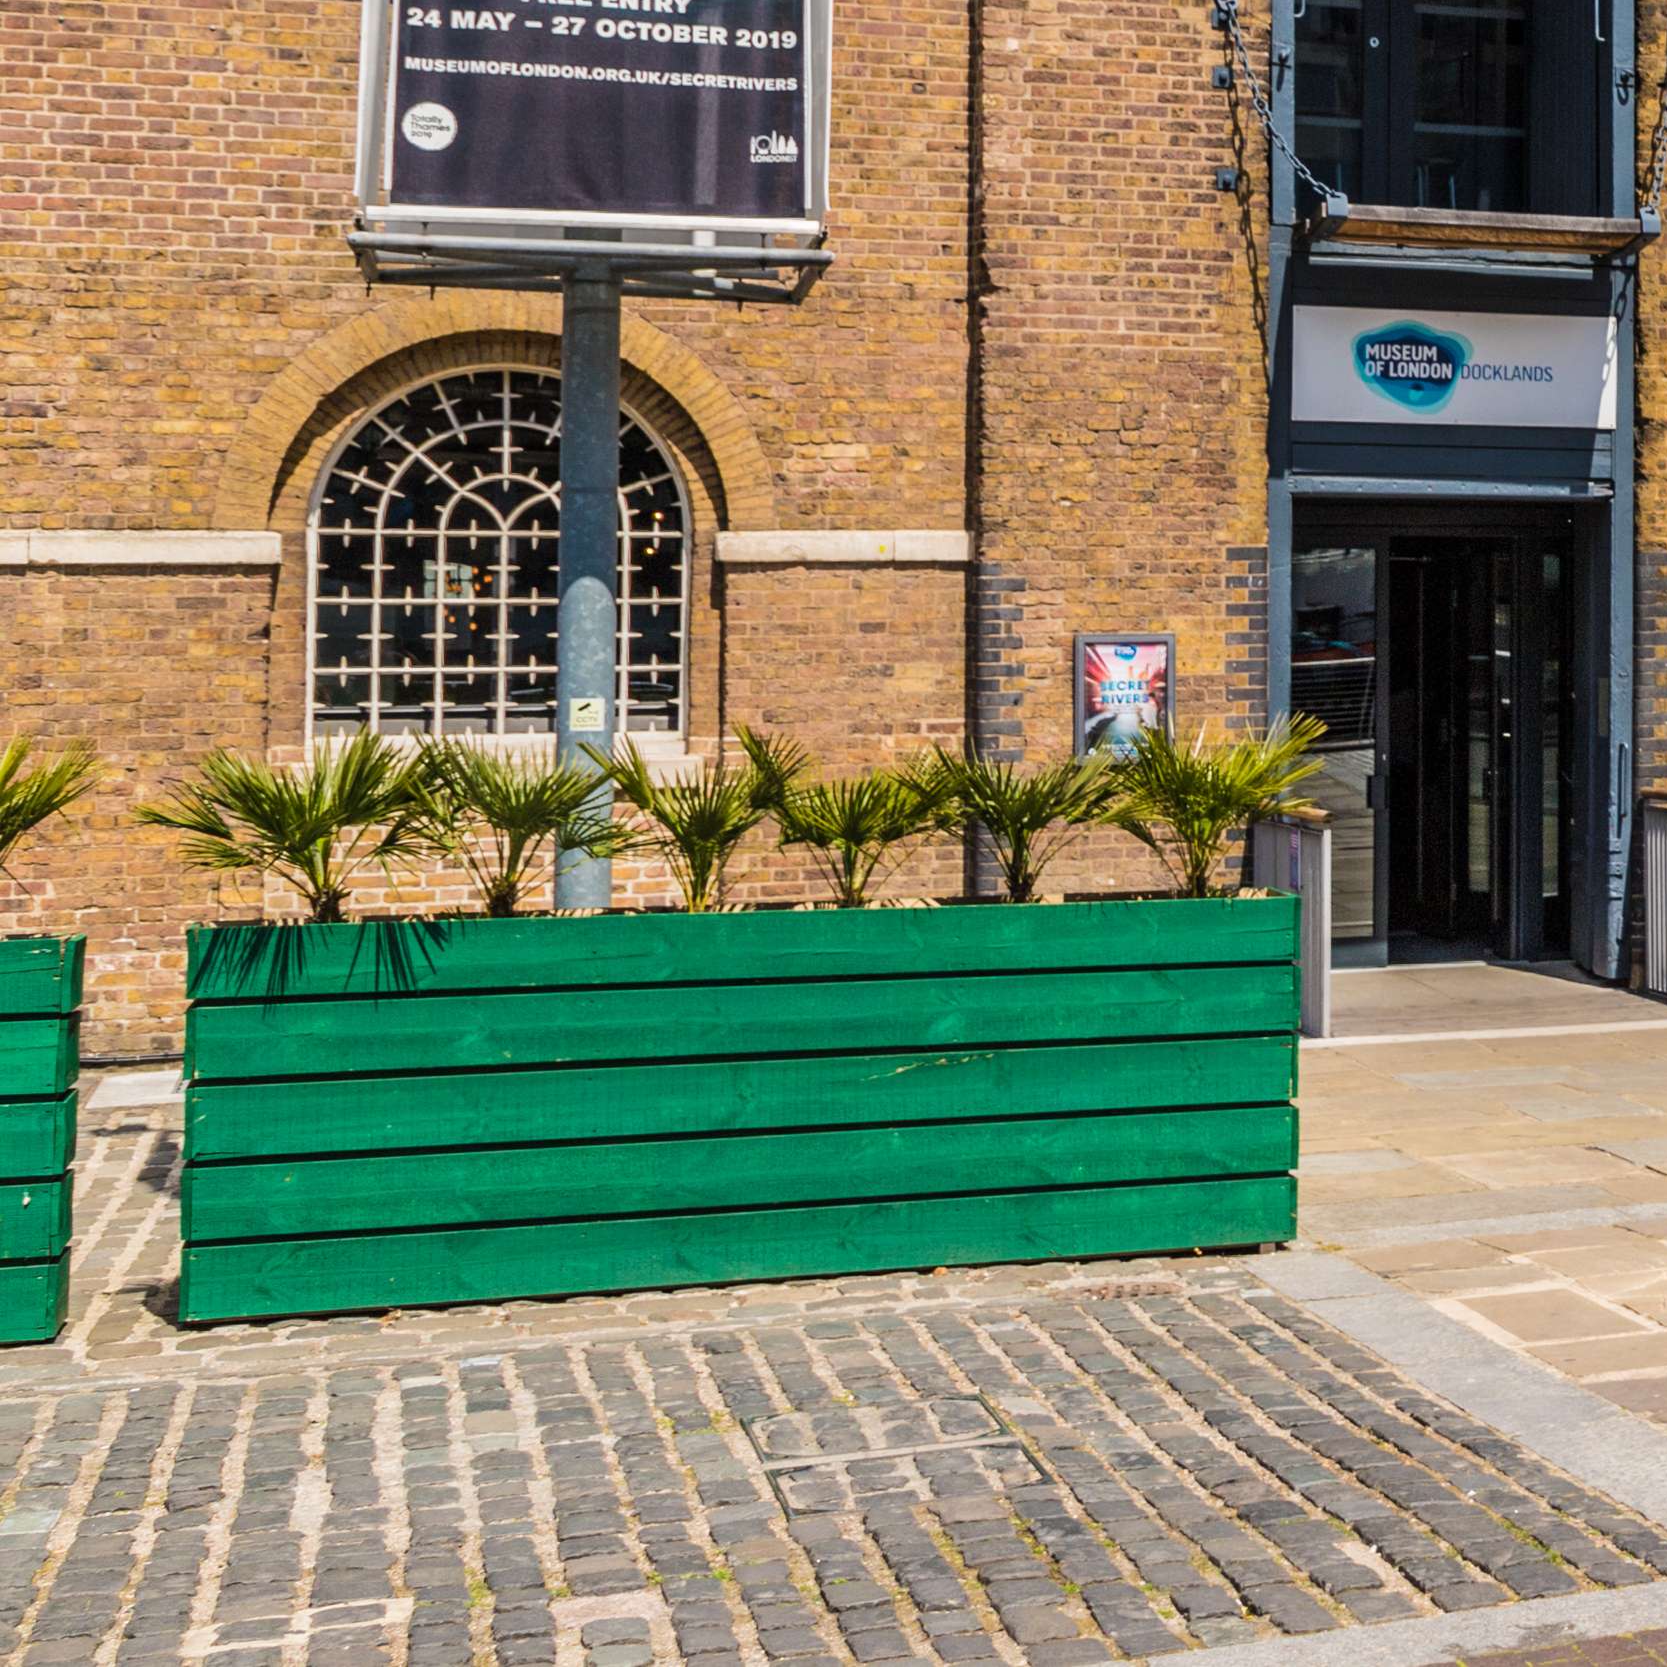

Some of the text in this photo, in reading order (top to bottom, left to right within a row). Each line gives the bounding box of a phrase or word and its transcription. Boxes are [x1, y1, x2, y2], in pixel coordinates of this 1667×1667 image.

[406, 7, 443, 28] 24
[450, 10, 516, 32] MAY
[551, 16, 587, 36] 27
[594, 19, 729, 47] OCTOBER
[735, 29, 798, 50] 2019
[404, 56, 799, 92] MUSEUMOFLONDON.ORG.UK/SECRETRIVERS
[1365, 344, 1438, 362] MUSEUM
[1364, 361, 1553, 383] OF LONDON DOCKLANDS
[1101, 694, 1149, 704] RIVERS
